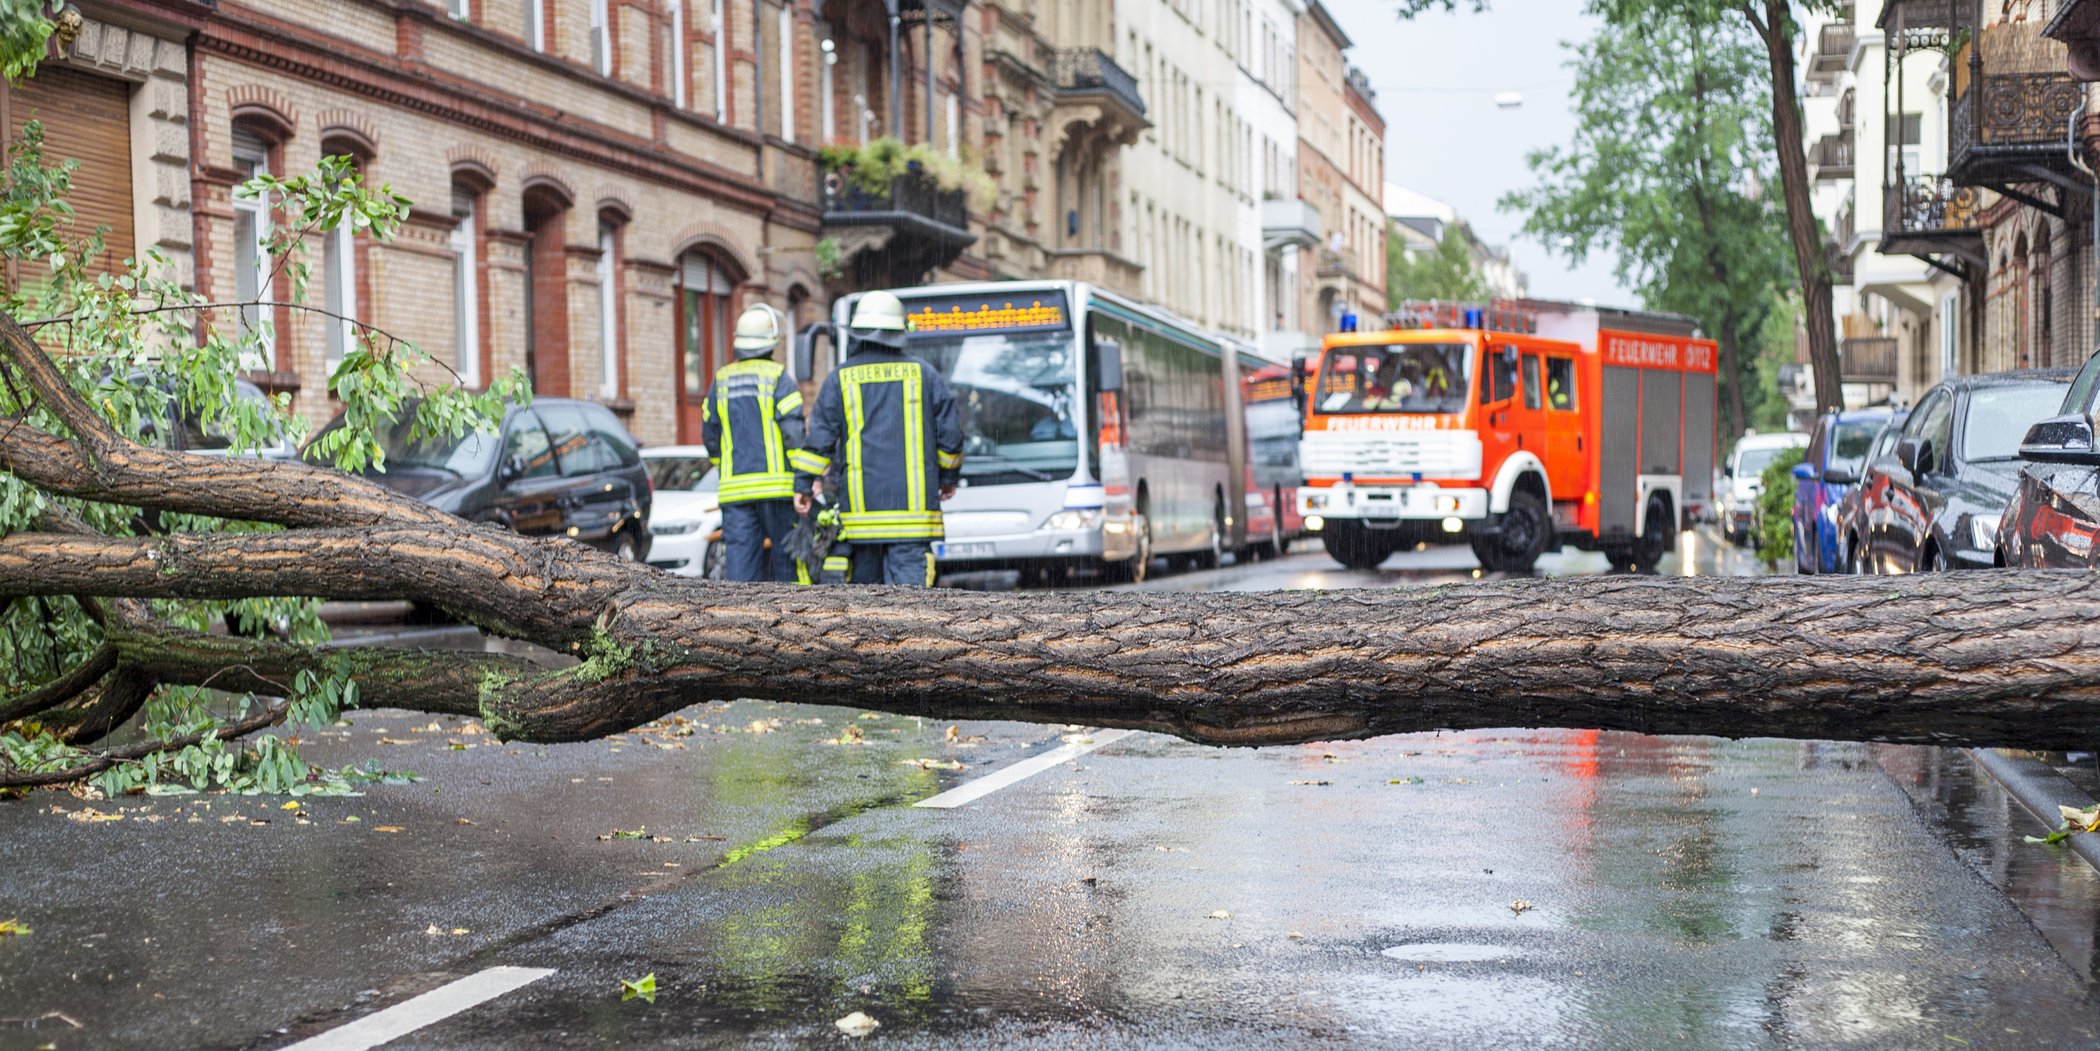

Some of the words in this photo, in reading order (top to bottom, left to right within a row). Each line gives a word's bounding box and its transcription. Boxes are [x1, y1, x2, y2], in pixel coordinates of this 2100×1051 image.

[1609, 338, 1678, 366] FEUERWEHR
[842, 364, 919, 383] FEUERWEHR
[1327, 415, 1437, 431] FEUERWEHR
